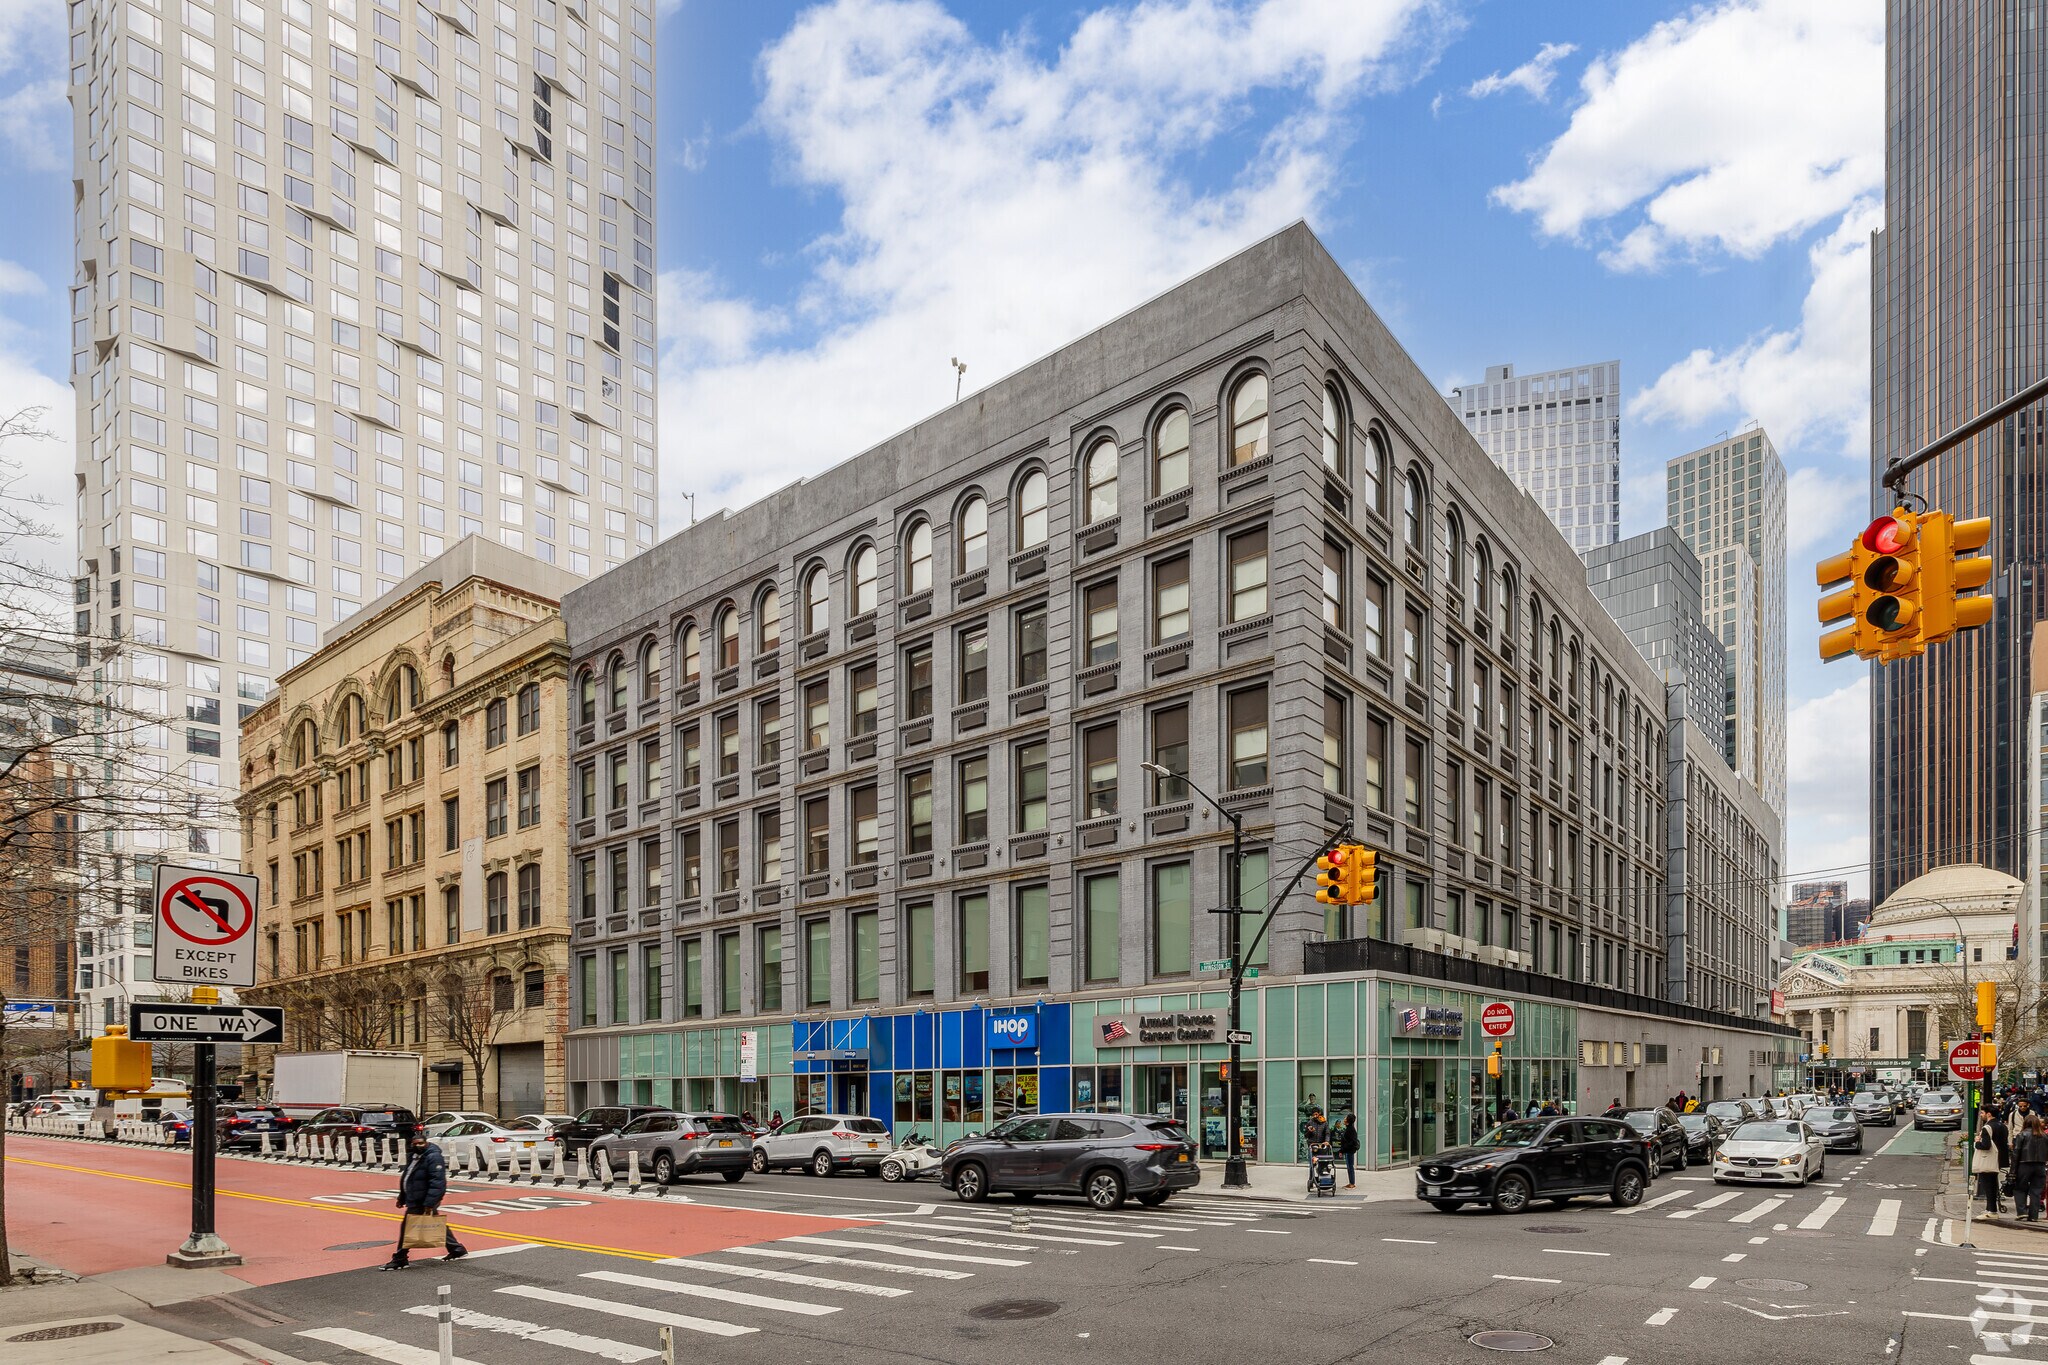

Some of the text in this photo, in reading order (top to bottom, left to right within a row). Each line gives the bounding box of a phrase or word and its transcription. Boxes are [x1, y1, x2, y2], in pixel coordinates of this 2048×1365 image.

[175, 948, 237, 964] EXCEPT
[182, 965, 229, 980] BIKES
[153, 1015, 262, 1032] ONE WAY
[993, 1018, 1028, 1038] IHOP
[1139, 1014, 1215, 1029] Armed Forces
[1139, 1028, 1214, 1043] Career Center
[1957, 1048, 1969, 1056] DO
[438, 1195, 593, 1218] BUS
